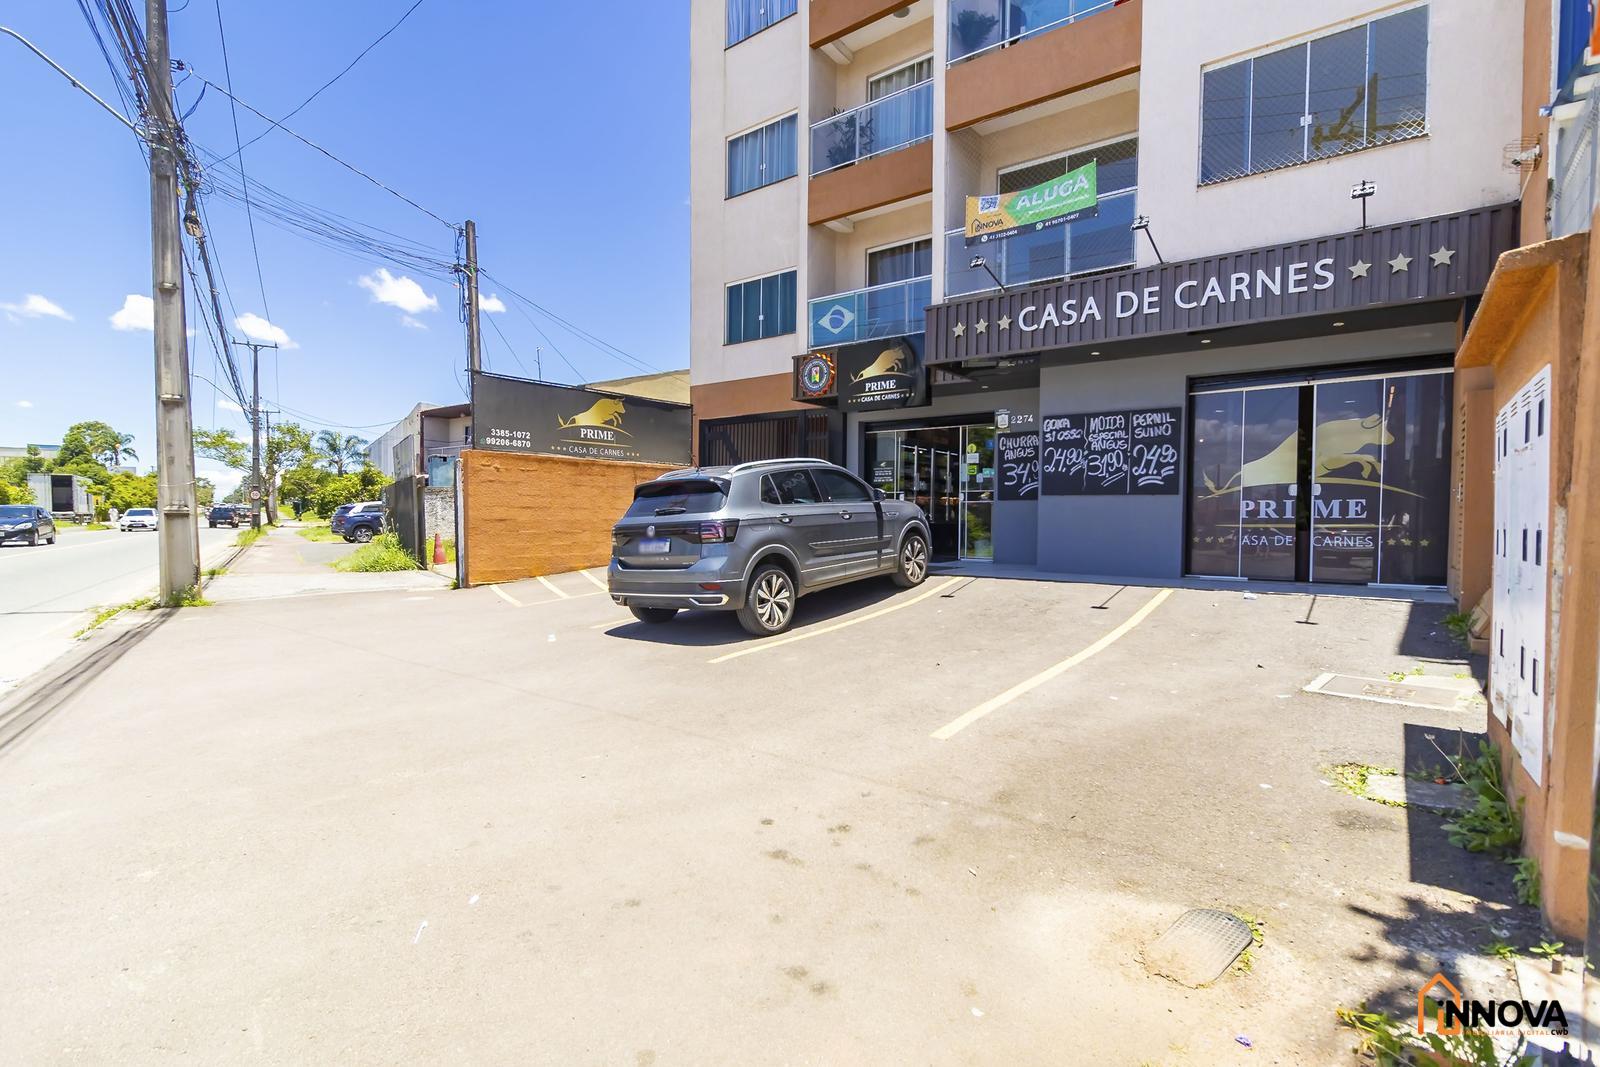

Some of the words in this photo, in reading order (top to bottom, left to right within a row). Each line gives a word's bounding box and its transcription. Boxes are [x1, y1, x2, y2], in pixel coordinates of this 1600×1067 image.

[1016, 174, 1089, 210] ALUGA
[1018, 296, 1101, 332] CASA
[1116, 286, 1160, 319] DE
[1174, 258, 1335, 309] CARNES
[865, 379, 897, 392] PRIME
[861, 395, 874, 403] CASA
[874, 394, 881, 402] DE
[1010, 414, 1034, 424] 2274
[1090, 414, 1125, 433] MOIDA
[1133, 412, 1176, 427] PERNIL
[491, 428, 531, 440] 3385-1072
[580, 428, 614, 441] PRIME
[1088, 430, 1129, 442] ESPECIAL
[1134, 423, 1172, 439] SUINO
[486, 437, 531, 448] 99206-6870
[1091, 440, 1128, 451] ANGUS
[568, 445, 587, 454] CASA
[589, 446, 598, 455] DE
[599, 448, 625, 457] CARNES
[1004, 447, 1036, 461] ANGUS
[1242, 499, 1367, 519] PRIME
[1240, 535, 1268, 546] ASA
[1274, 535, 1292, 546] DE
[1313, 536, 1374, 547] CARNES
